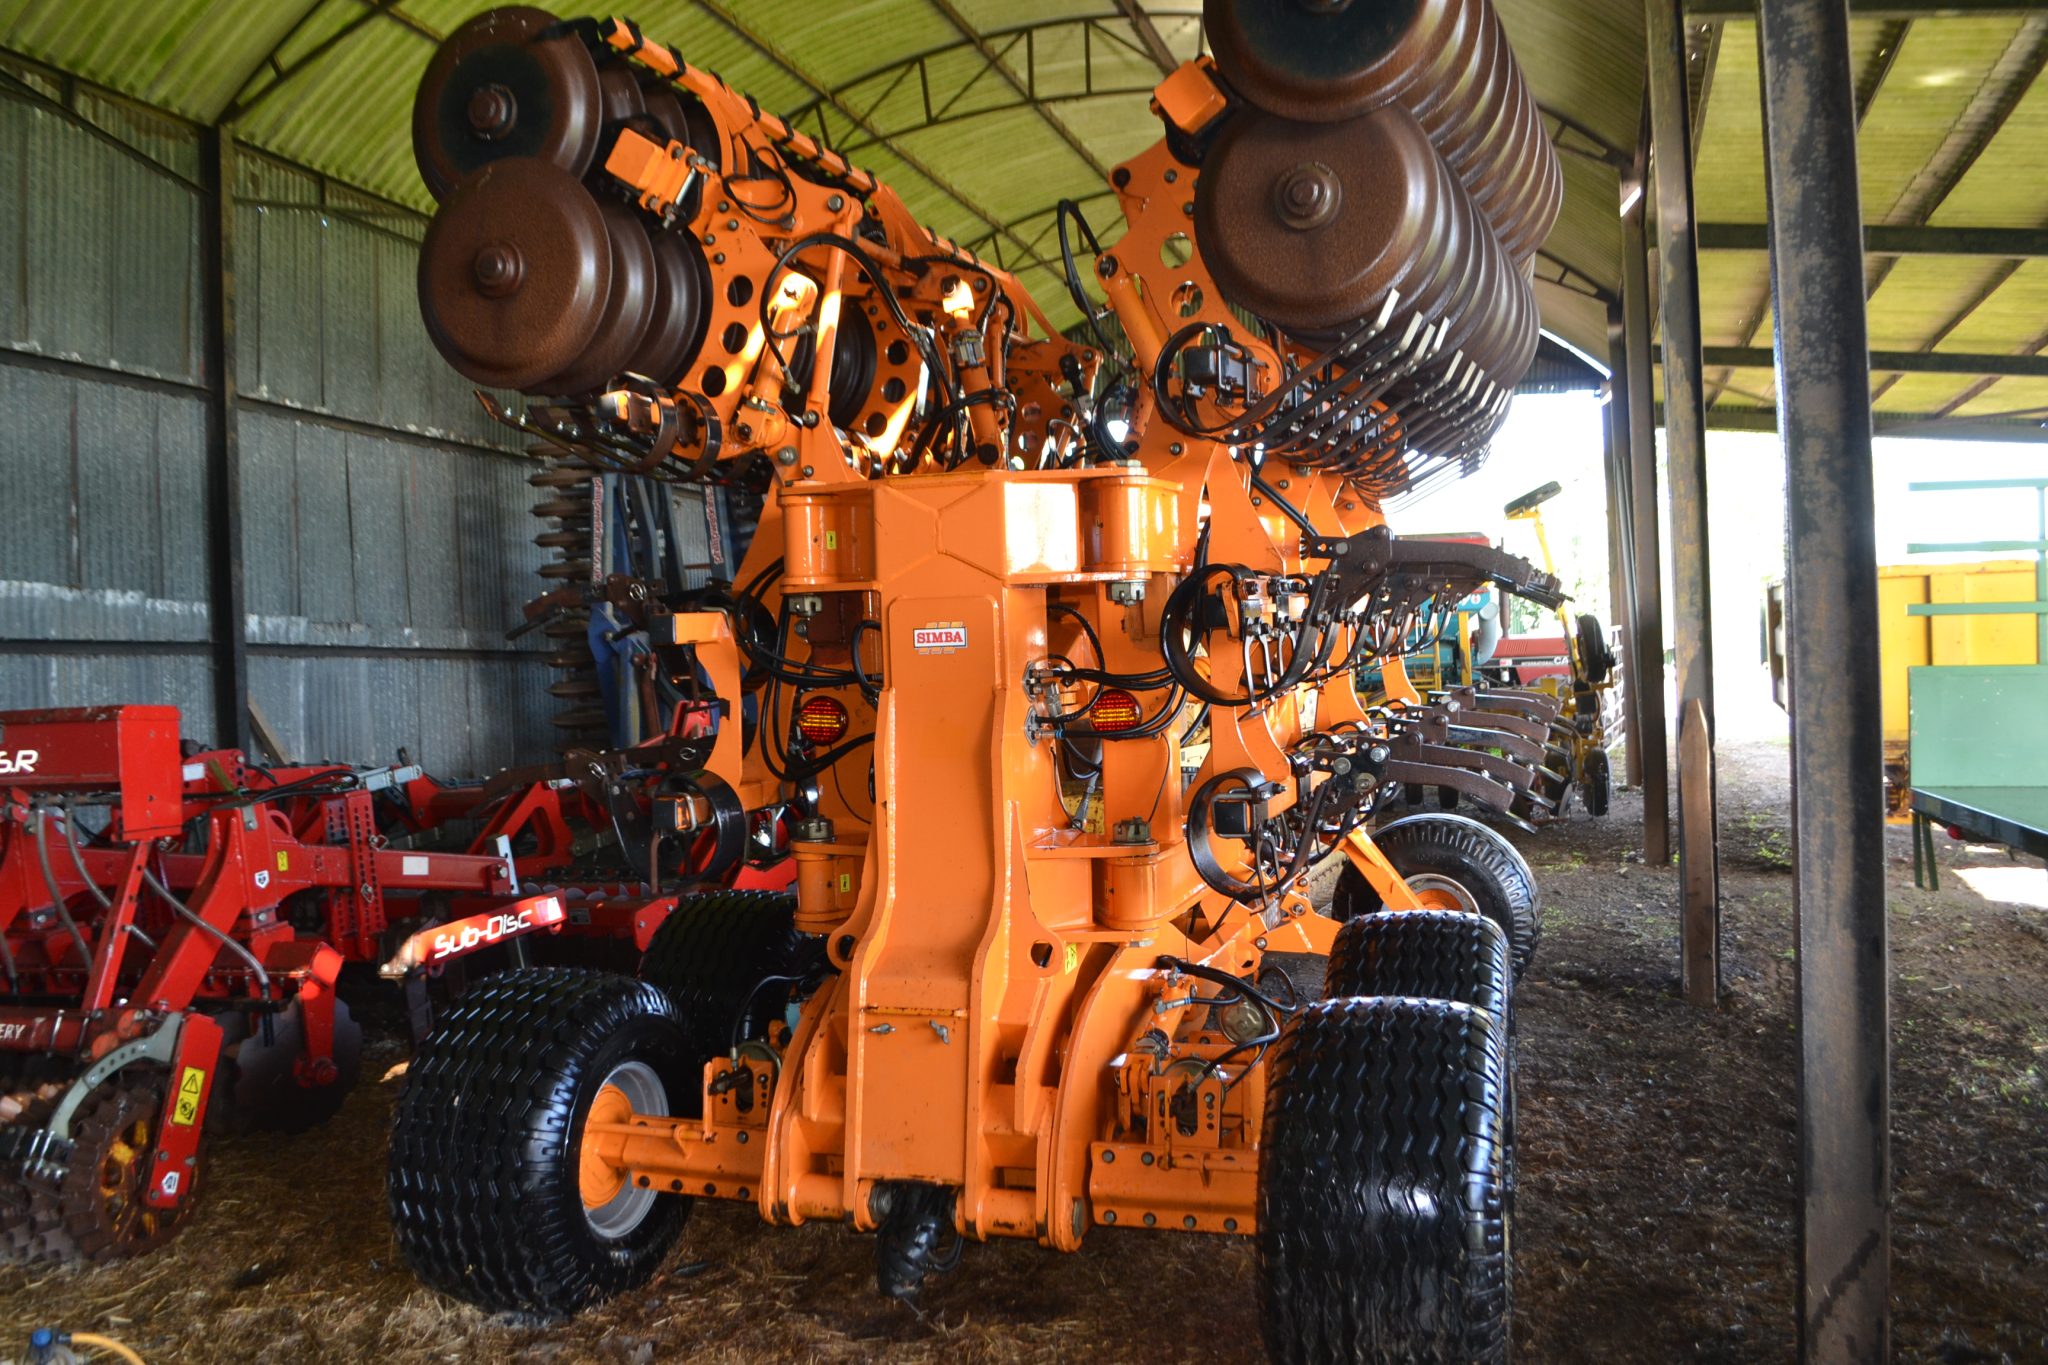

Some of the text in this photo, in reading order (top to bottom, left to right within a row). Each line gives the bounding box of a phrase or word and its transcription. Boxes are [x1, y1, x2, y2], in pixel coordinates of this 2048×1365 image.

[916, 631, 963, 644] SIMBA
[1553, 656, 1569, 665] CA
[434, 909, 532, 958] Sub-Disc
